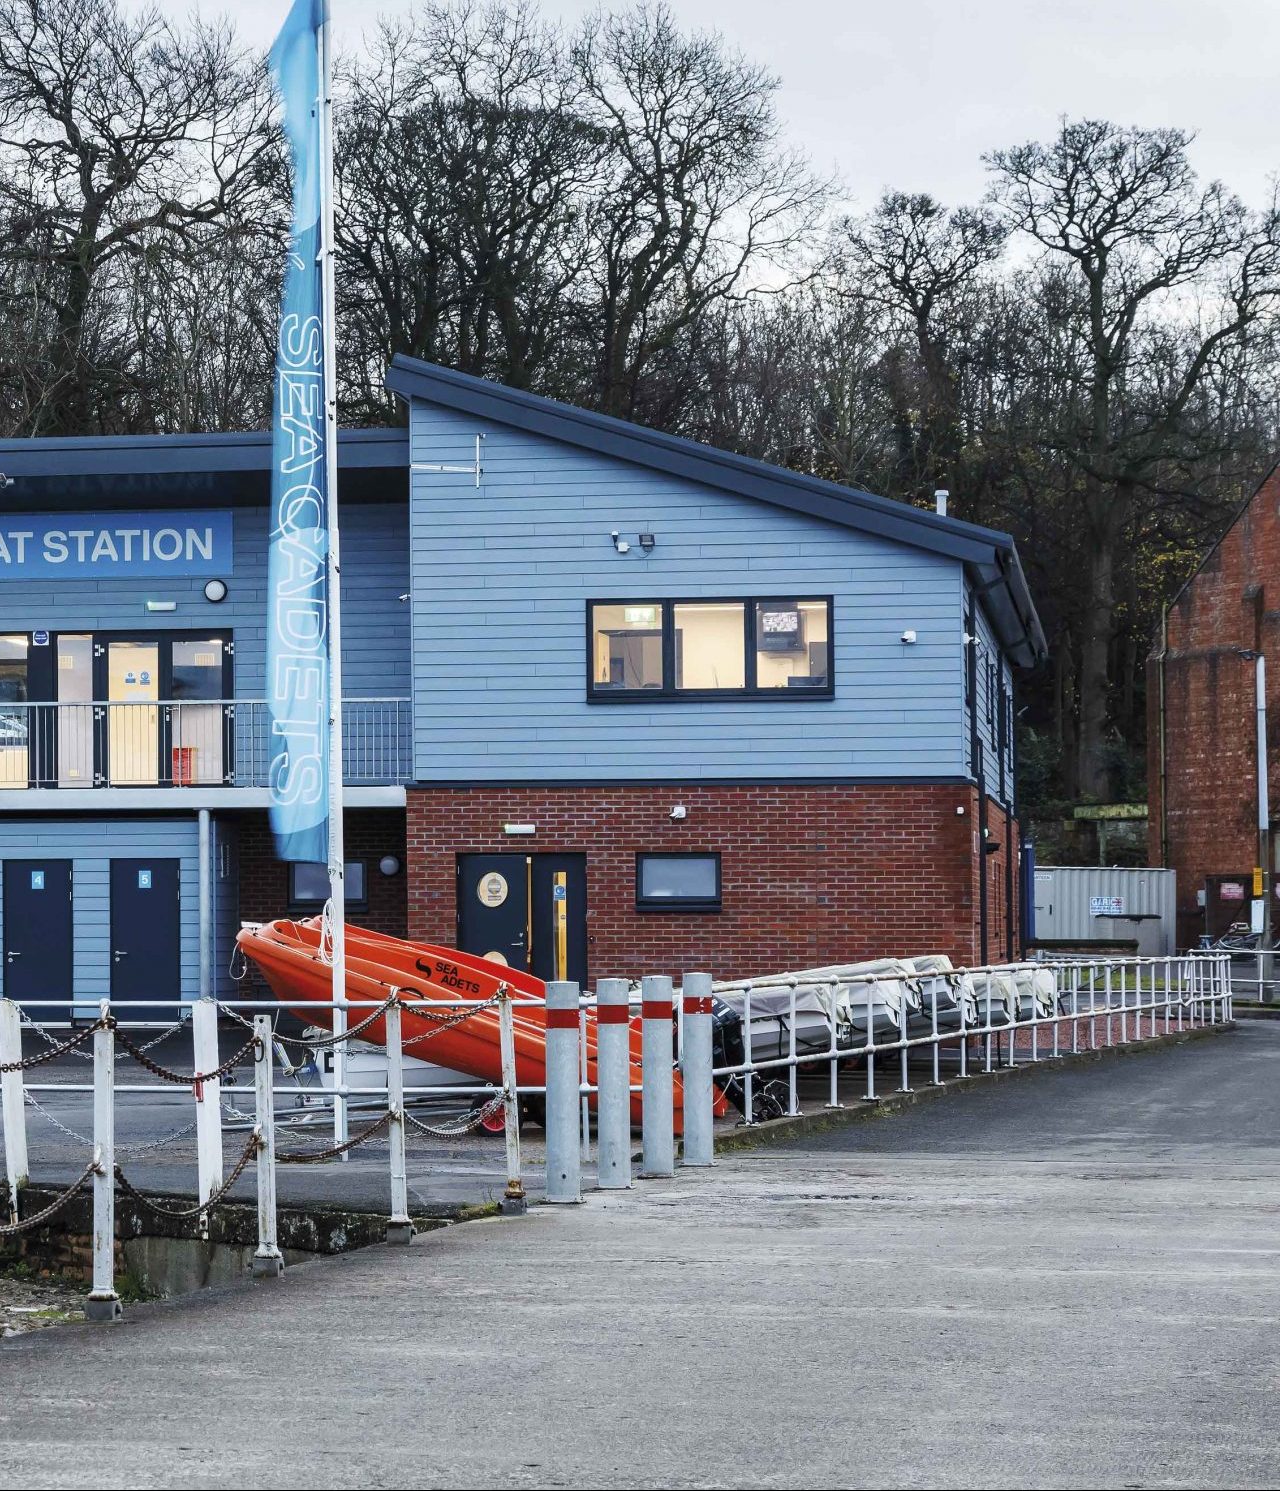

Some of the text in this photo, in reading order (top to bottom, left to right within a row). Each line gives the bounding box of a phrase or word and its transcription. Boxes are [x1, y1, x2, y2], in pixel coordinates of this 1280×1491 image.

[42, 527, 213, 564] STATION
[270, 313, 326, 806] SEA CADETS
[34, 875, 42, 885] 4
[141, 875, 149, 885] 5
[435, 962, 458, 977] SEA
